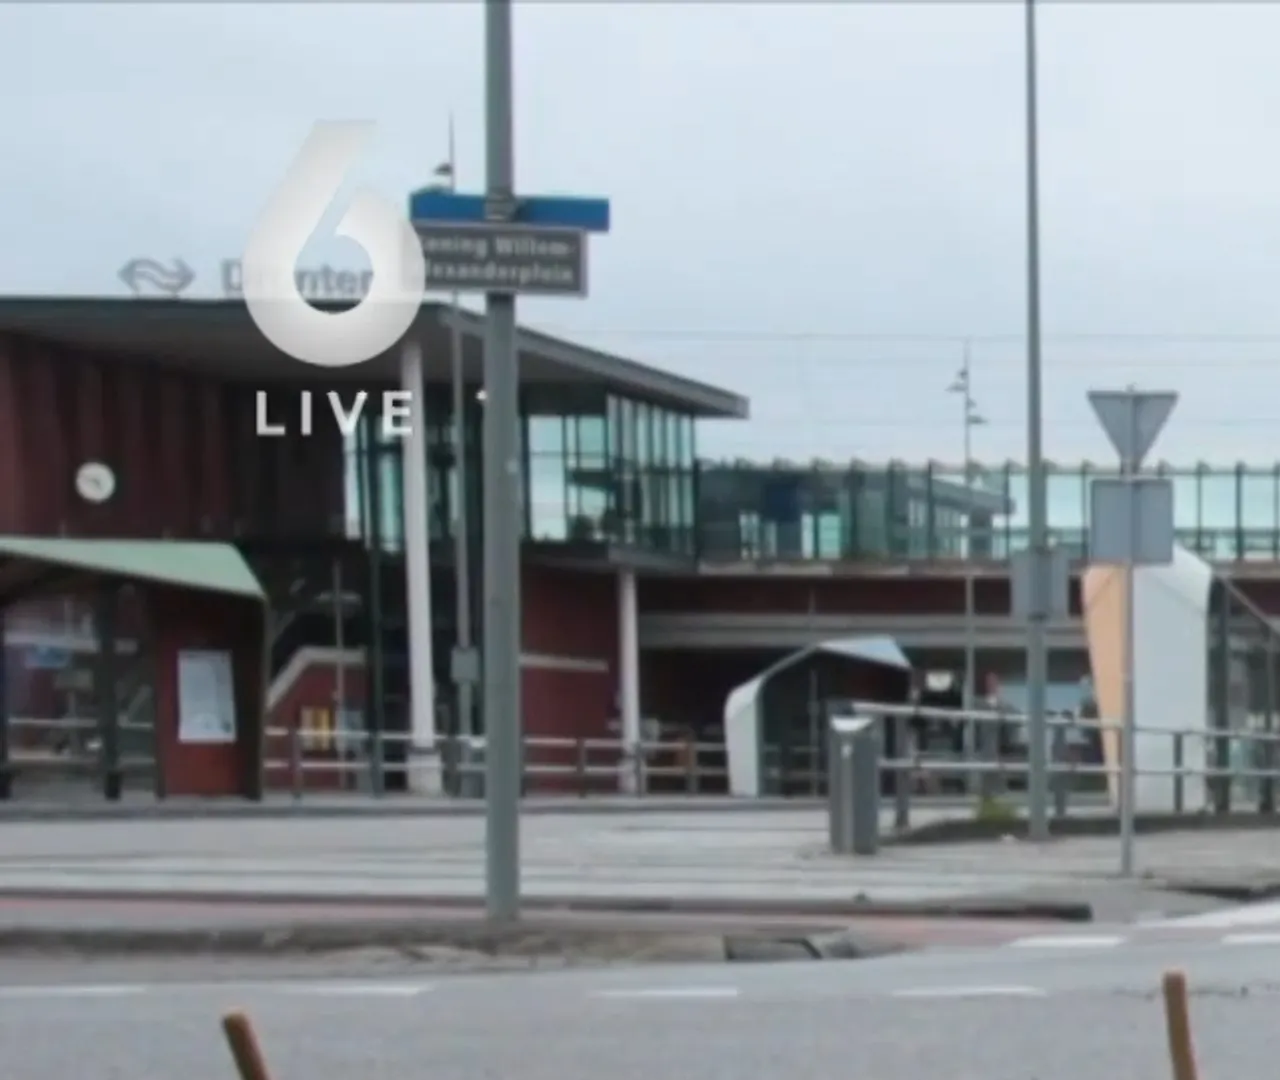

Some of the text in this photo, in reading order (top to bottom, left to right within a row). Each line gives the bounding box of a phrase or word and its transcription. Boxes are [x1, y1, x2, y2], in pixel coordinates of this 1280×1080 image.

[422, 236, 488, 260] oning
[221, 257, 374, 295] Dnter
[424, 258, 574, 285] lexanderplein
